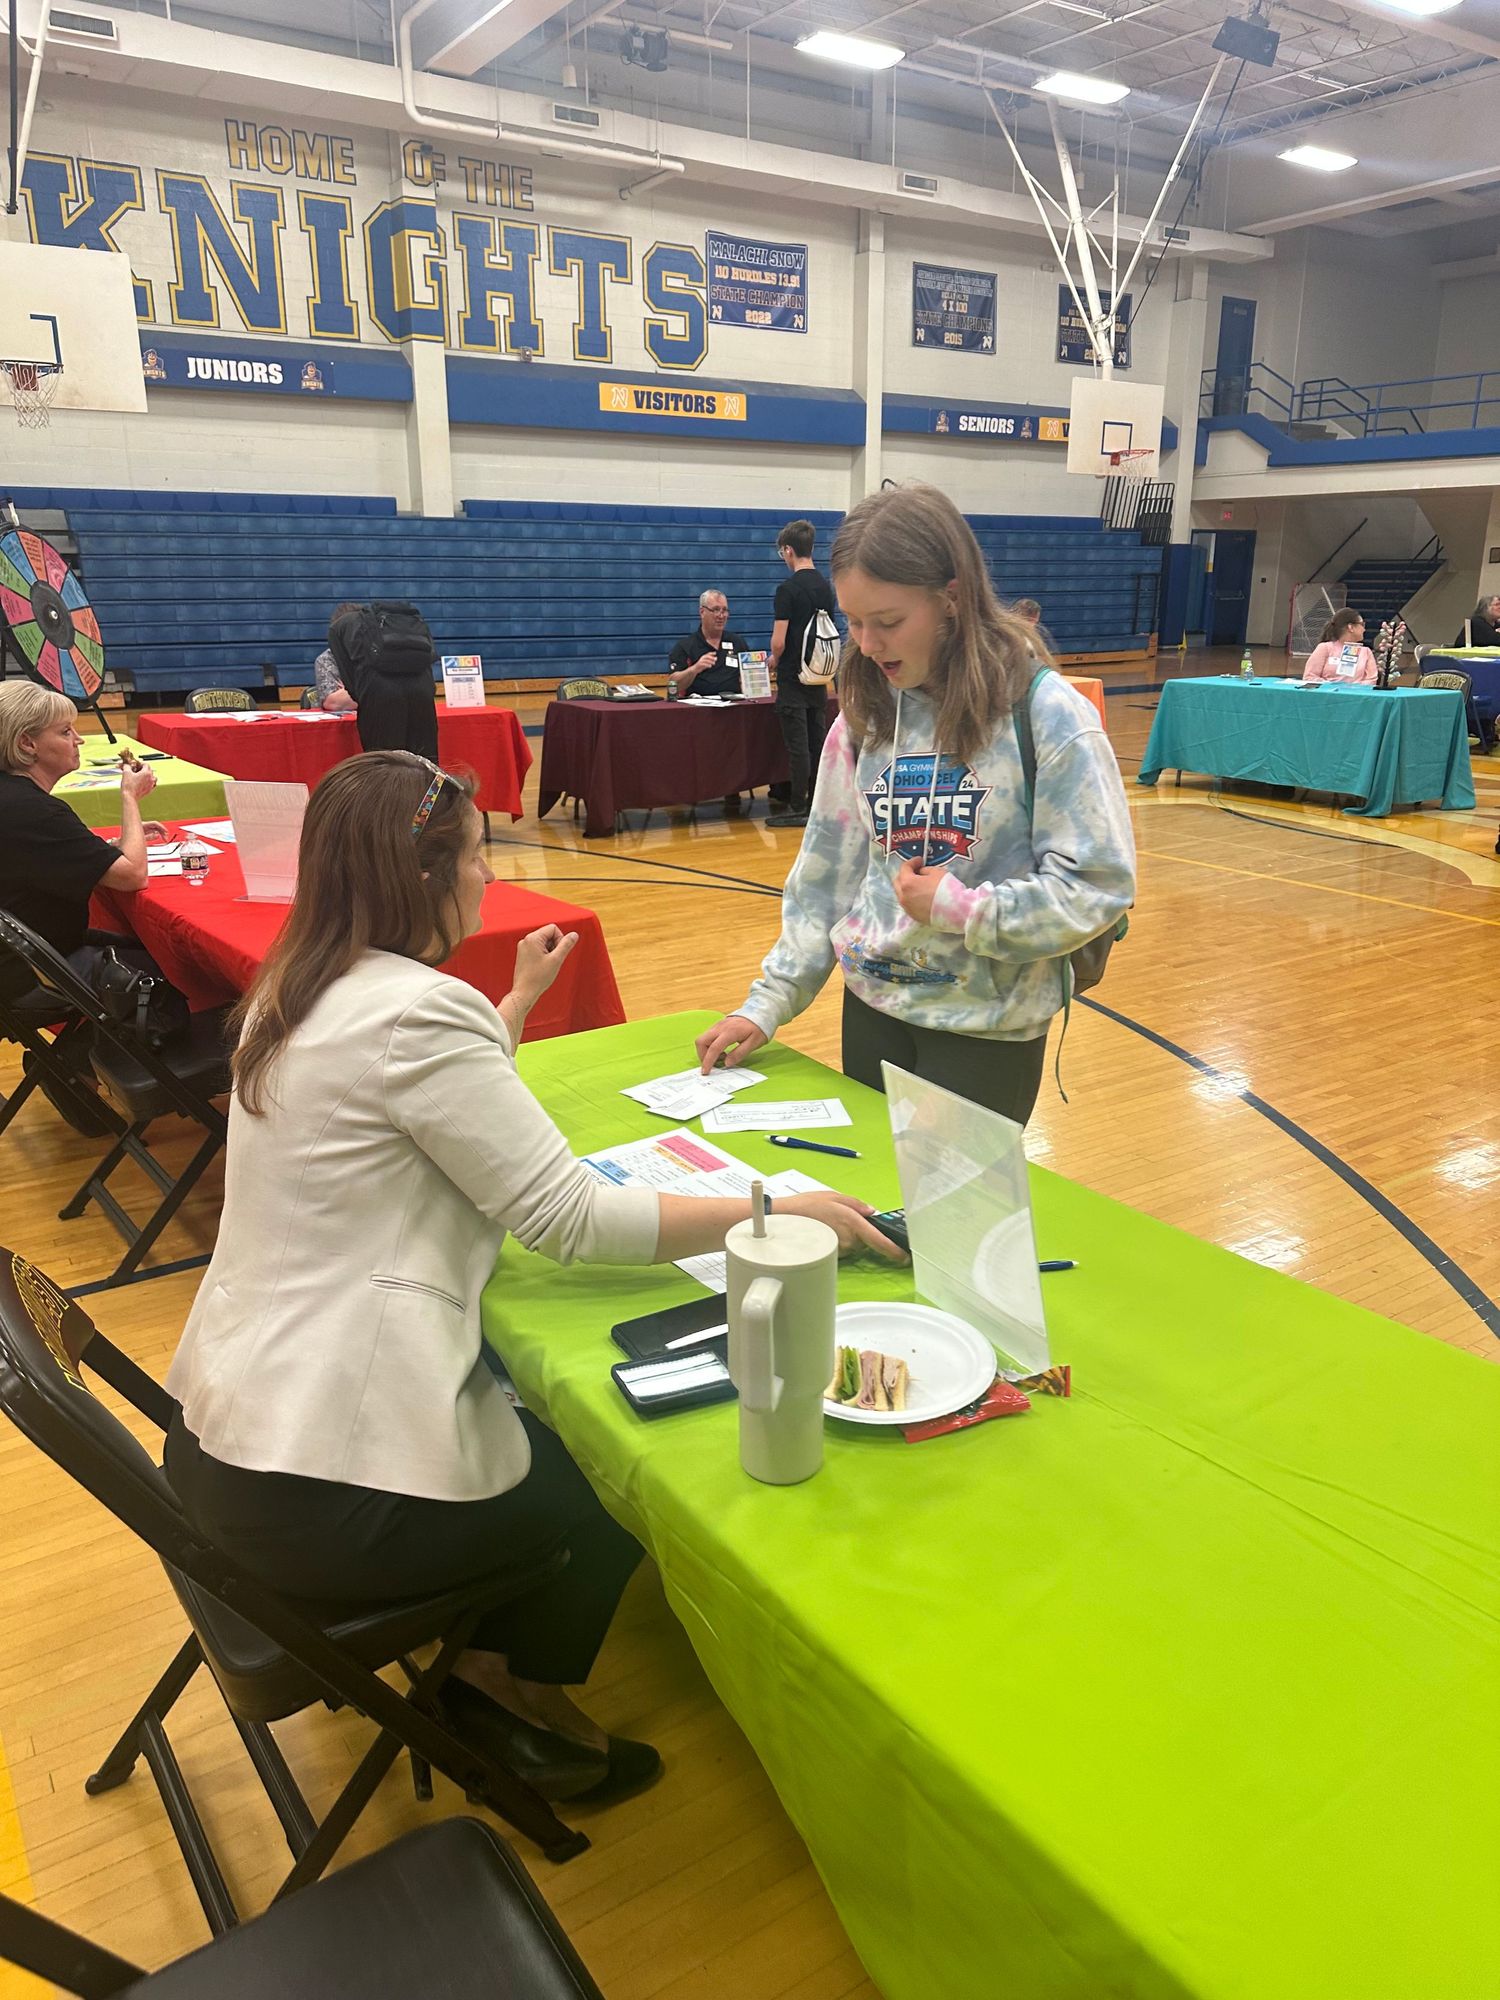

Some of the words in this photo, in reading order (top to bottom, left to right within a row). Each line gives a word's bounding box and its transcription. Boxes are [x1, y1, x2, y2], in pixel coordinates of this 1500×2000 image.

[224, 118, 357, 186] HOME
[403, 139, 446, 188] OF
[458, 156, 535, 212] THE
[16, 149, 708, 371] KNIGHTS
[709, 240, 769, 266] MALACHI
[769, 249, 805, 270] SNOW
[710, 284, 747, 304] STATE
[747, 288, 806, 310] CHAMPION
[744, 309, 773, 326] 2022
[955, 302, 968, 315] 100
[915, 310, 943, 328] STATE
[943, 313, 994, 333] CHAMPIONS
[943, 331, 963, 346] 2015
[186, 356, 284, 385] JUNIORS
[633, 389, 717, 415] VISITORS
[958, 415, 1015, 434] SENIORS
[875, 783, 885, 792] 20
[893, 774, 926, 787] OHIO
[962, 779, 974, 789] 24
[873, 794, 973, 831] STATE
[891, 829, 959, 846] CHAMPINSHIPS
